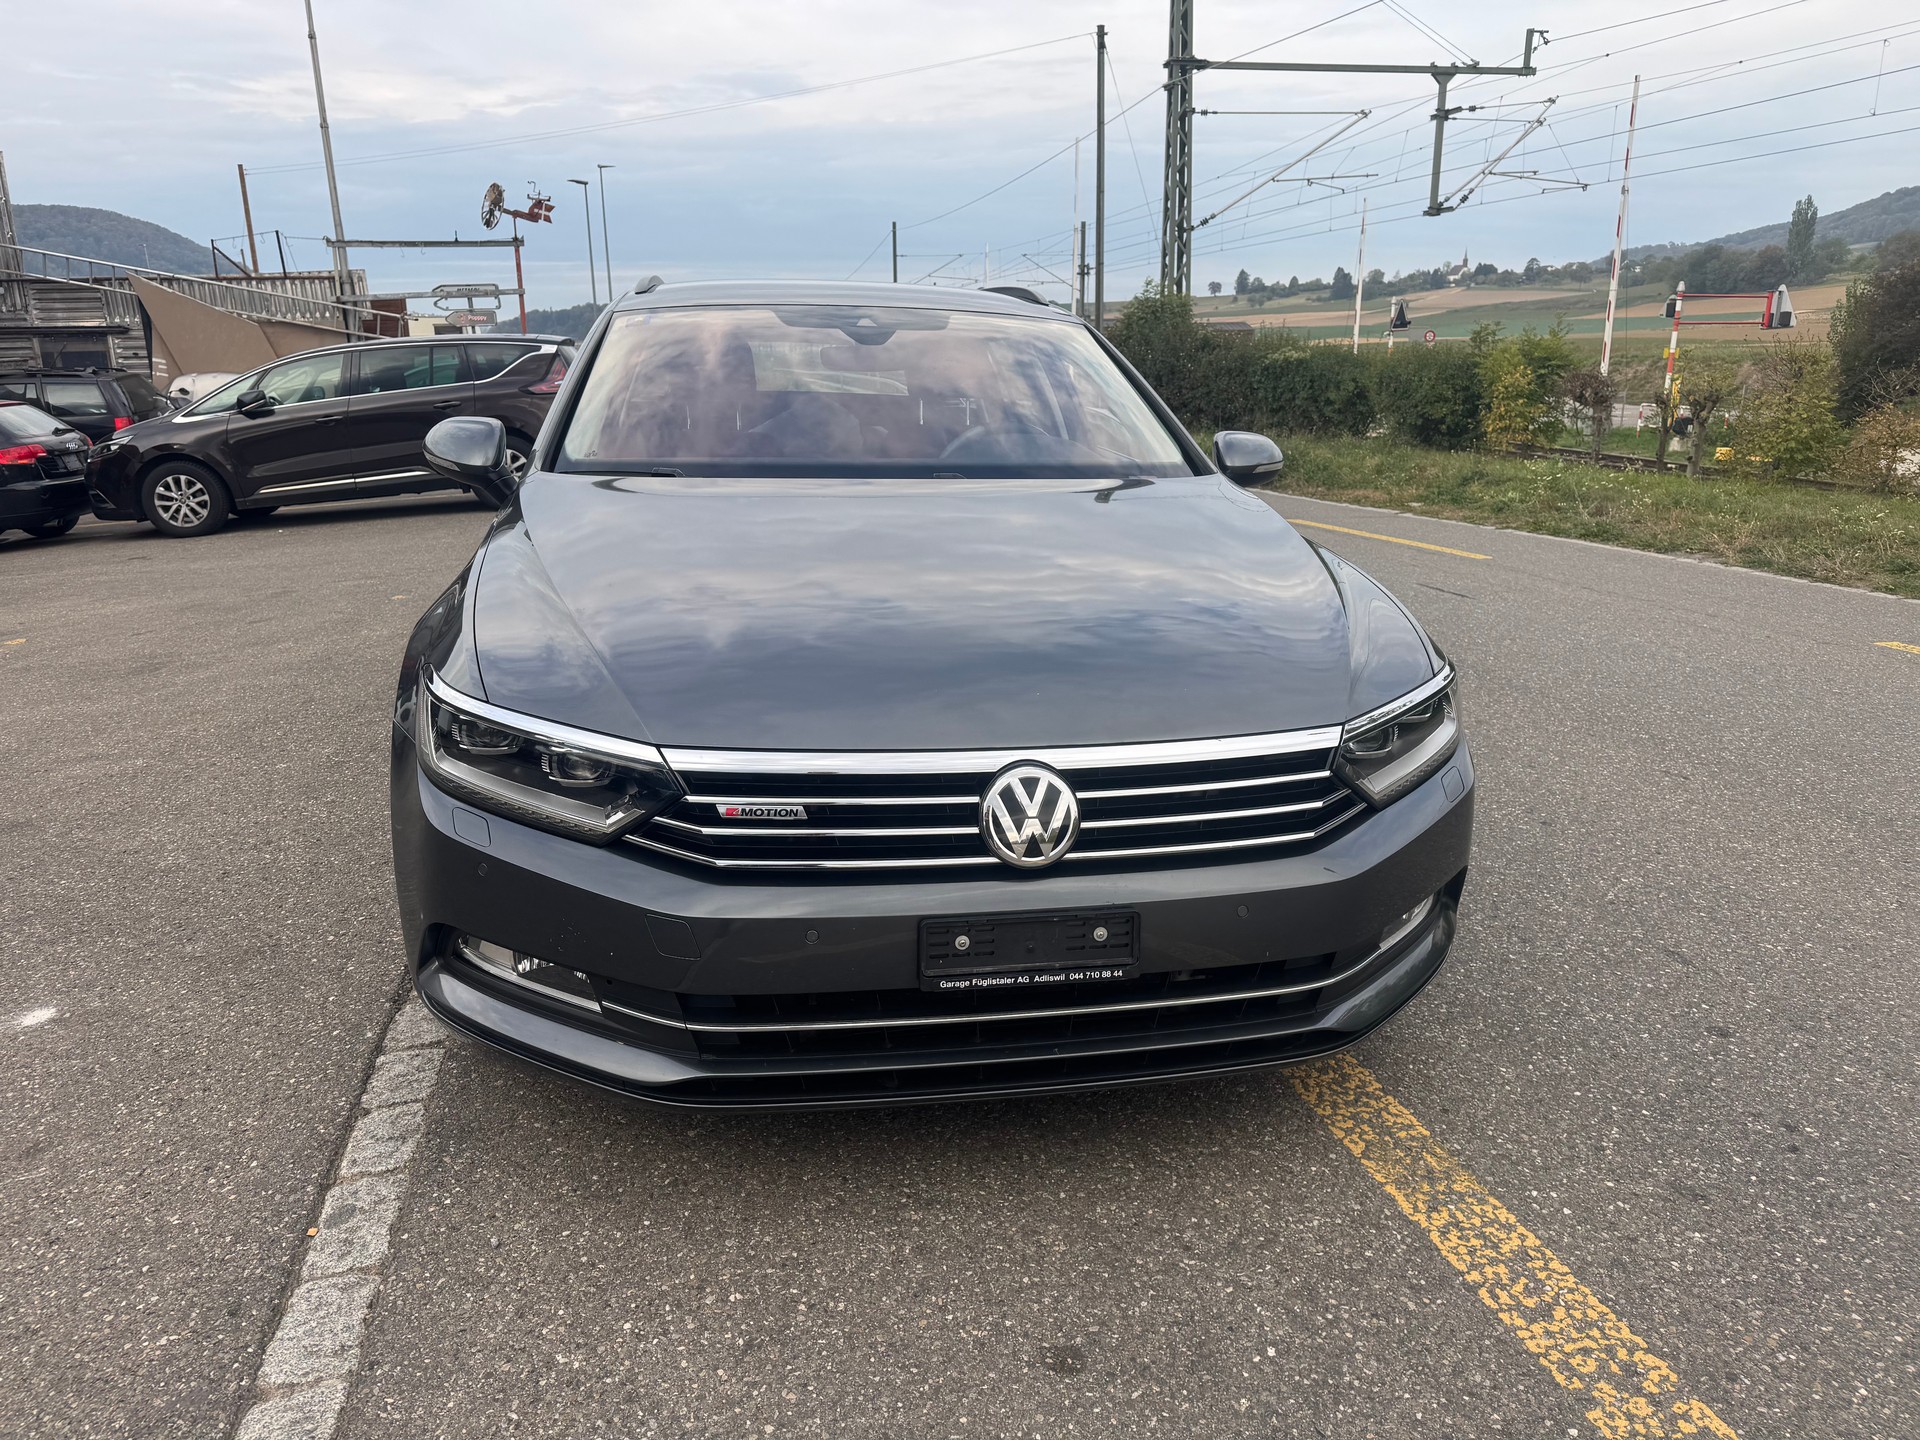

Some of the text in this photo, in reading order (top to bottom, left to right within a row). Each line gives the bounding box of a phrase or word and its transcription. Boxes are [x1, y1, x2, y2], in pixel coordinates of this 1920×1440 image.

[985, 768, 1077, 865] VW
[939, 969, 1123, 989] Garage Füglistaler AG Adliswil 044 710 88 44
